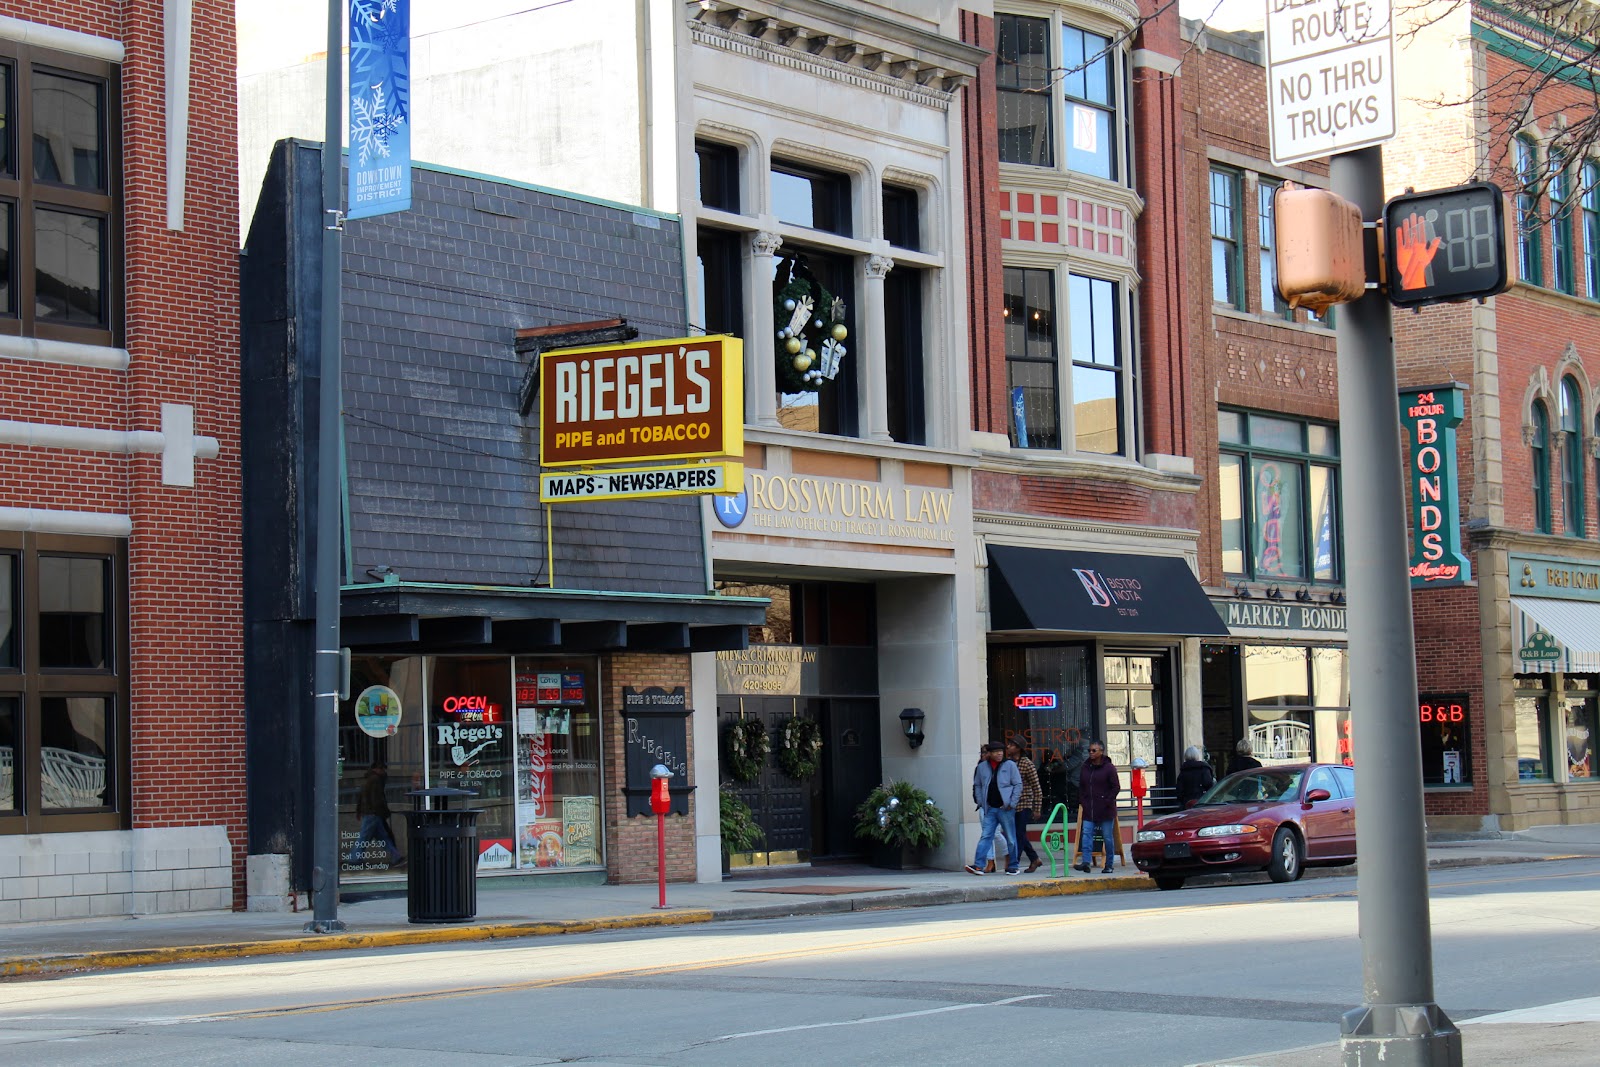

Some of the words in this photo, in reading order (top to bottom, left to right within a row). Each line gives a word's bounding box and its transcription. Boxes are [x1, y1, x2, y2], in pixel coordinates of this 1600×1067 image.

[1292, 1, 1369, 46] ROUTE
[1280, 73, 1312, 106] NO
[1320, 55, 1383, 97] THRU
[1287, 95, 1379, 141] TRUCKS
[356, 165, 402, 186] DOWNTOWN
[356, 180, 402, 194] IMPROVEMENT
[356, 188, 402, 202] DISTRICT
[1417, 392, 1435, 405] 24
[1408, 404, 1445, 417] HOUR
[555, 430, 593, 449] PIPE
[597, 429, 625, 446] and
[630, 422, 711, 444] TOBACCO
[549, 477, 595, 496] MAPS
[609, 469, 716, 493] NEWSPAPERS
[1417, 418, 1443, 561] BONDS
[751, 473, 895, 522] ROSSWURM
[904, 488, 955, 526] LAW
[753, 513, 772, 527] THE
[774, 515, 793, 529] LAW
[795, 516, 828, 532] OFFICE
[830, 519, 842, 533] OF
[845, 520, 878, 536] TRACEY
[940, 529, 956, 543] LLC
[1107, 577, 1142, 590] BISTRO
[1546, 568, 1569, 589] B&B
[1571, 571, 1599, 590] LOAN
[1113, 590, 1143, 601] NOTA
[1228, 603, 1291, 627] MARKEY
[1301, 607, 1347, 630] BONDI
[716, 650, 740, 661] MILY
[741, 650, 748, 661] &
[750, 650, 796, 662] CRIMINAL
[797, 651, 816, 663] LAW
[1521, 650, 1539, 658] B&B
[1541, 650, 1559, 658] Loan
[736, 663, 788, 676] ATTORNEYS
[744, 680, 782, 691] 420-9095
[443, 696, 487, 713] OPEN
[627, 695, 644, 704] PIPE
[652, 695, 684, 705] TOBACCO
[1014, 696, 1053, 707] OPEN
[437, 722, 503, 745] Riegel's
[549, 748, 569, 756] Lounge
[440, 771, 456, 779] PIPE
[465, 769, 502, 779] TOBACCO
[341, 831, 361, 839] Hours
[341, 841, 353, 849] M-F
[354, 840, 386, 849] 9:00-5:30
[355, 851, 387, 859] 9:00-5:30
[341, 862, 364, 871] Closed
[365, 862, 390, 871] Sunday
